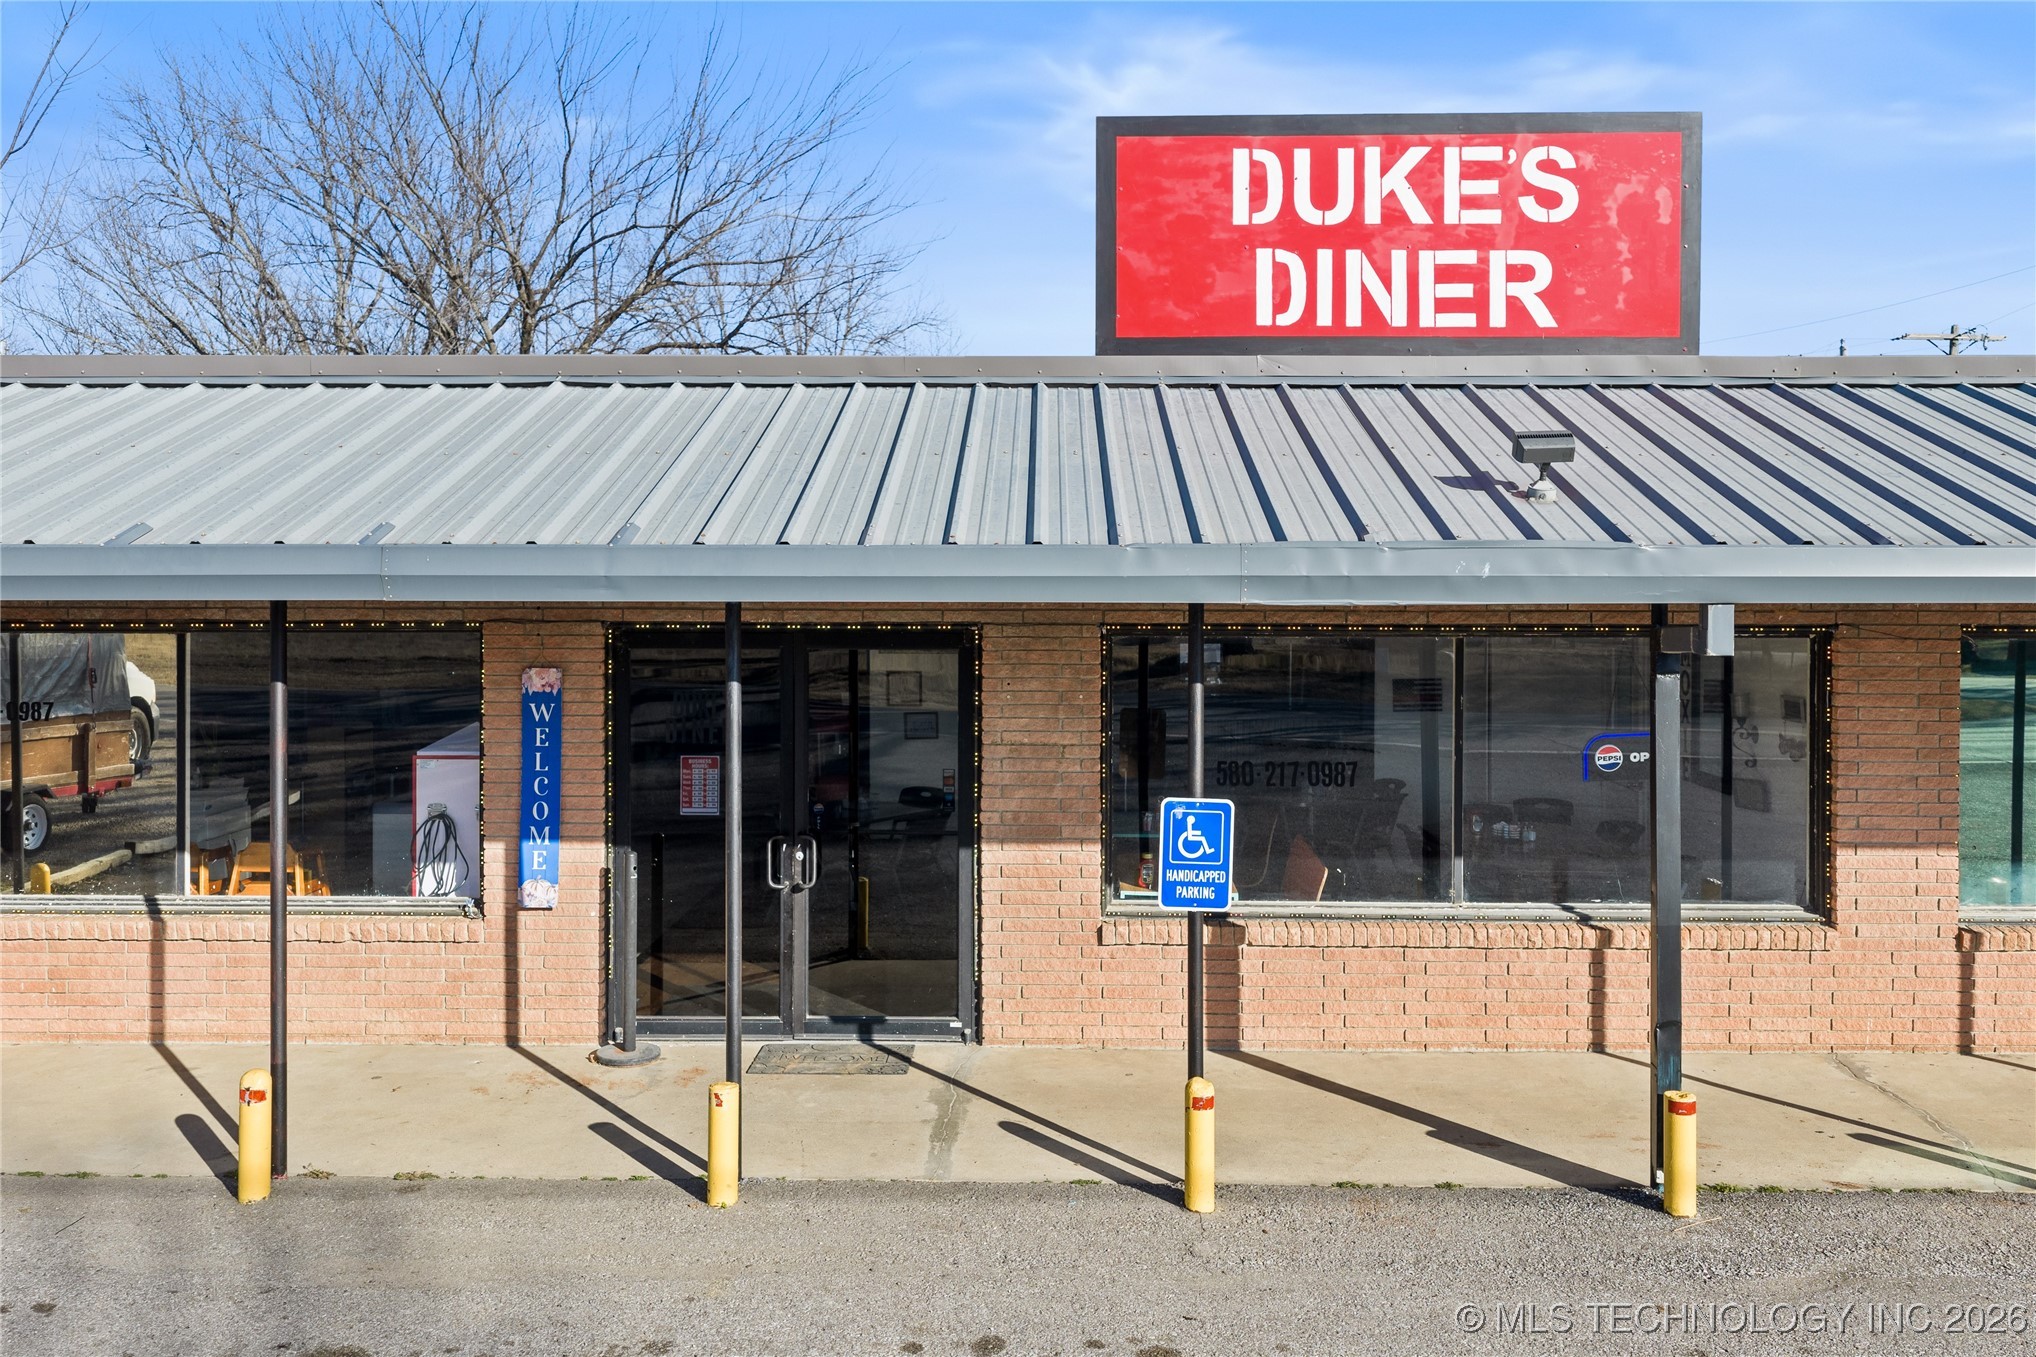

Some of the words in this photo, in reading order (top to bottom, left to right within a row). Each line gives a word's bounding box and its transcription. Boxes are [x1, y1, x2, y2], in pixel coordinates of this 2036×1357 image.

[1232, 146, 1580, 226] DUKE'S
[1256, 247, 1559, 328] DINER
[1629, 752, 1650, 762] OP
[528, 703, 555, 870] WELCOME
[1166, 869, 1226, 884] HANDICAPPED
[1175, 885, 1215, 899] PARKING
